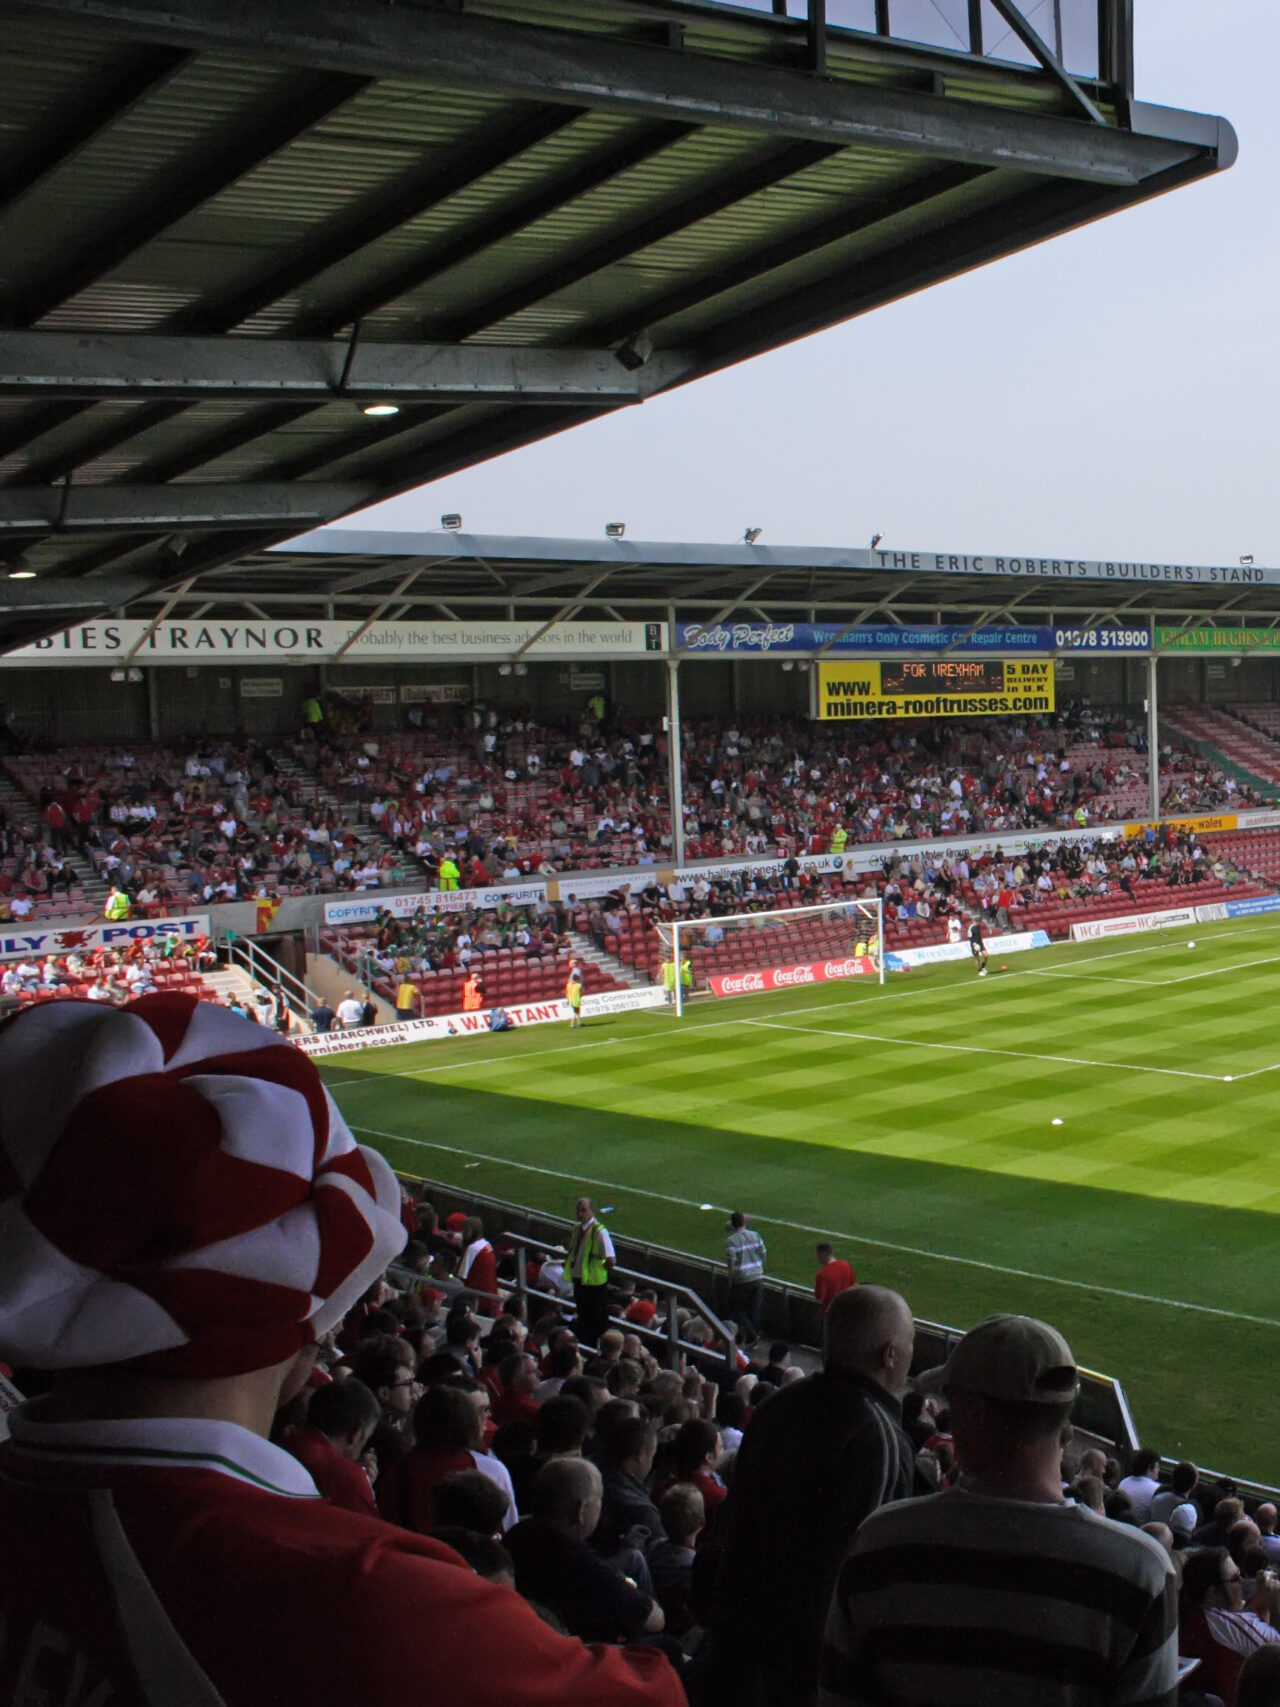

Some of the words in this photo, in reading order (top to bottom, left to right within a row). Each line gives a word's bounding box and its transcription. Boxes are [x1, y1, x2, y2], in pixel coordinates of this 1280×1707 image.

[877, 552, 920, 569] THE
[935, 555, 984, 572] ERIC
[995, 558, 1087, 576] ROBERTS
[1097, 562, 1201, 581] (BUILDERS)
[1210, 567, 1265, 582] STAND
[143, 627, 324, 649] TRAYNOR
[408, 630, 429, 645] the
[432, 630, 457, 645] best
[461, 630, 511, 645] business
[600, 630, 632, 644] world
[684, 624, 731, 650] Body
[733, 624, 795, 650] Perfect
[875, 631, 899, 646] Only
[902, 632, 949, 645] Cosmetic
[971, 632, 1002, 646] Repair
[1005, 632, 1038, 645] Centre
[1100, 630, 1148, 647] 313900
[902, 663, 927, 678] FOR
[1006, 664, 1016, 675] 5
[1021, 664, 1048, 675] DAY
[1006, 685, 1018, 693] in
[826, 696, 1050, 718] minera-rooftrusses.com
[394, 894, 432, 908] 01745
[435, 891, 478, 904] 816473
[102, 920, 200, 943] POST
[916, 944, 964, 960] Wrexham
[773, 965, 814, 986] Coca-Cola
[824, 959, 864, 978] Coca-Cola
[721, 973, 764, 993] Coca-Cola
[601, 990, 654, 1002] Contractors
[324, 1022, 410, 1044] (MARCHWIEL)
[412, 1019, 439, 1030] LTD.
